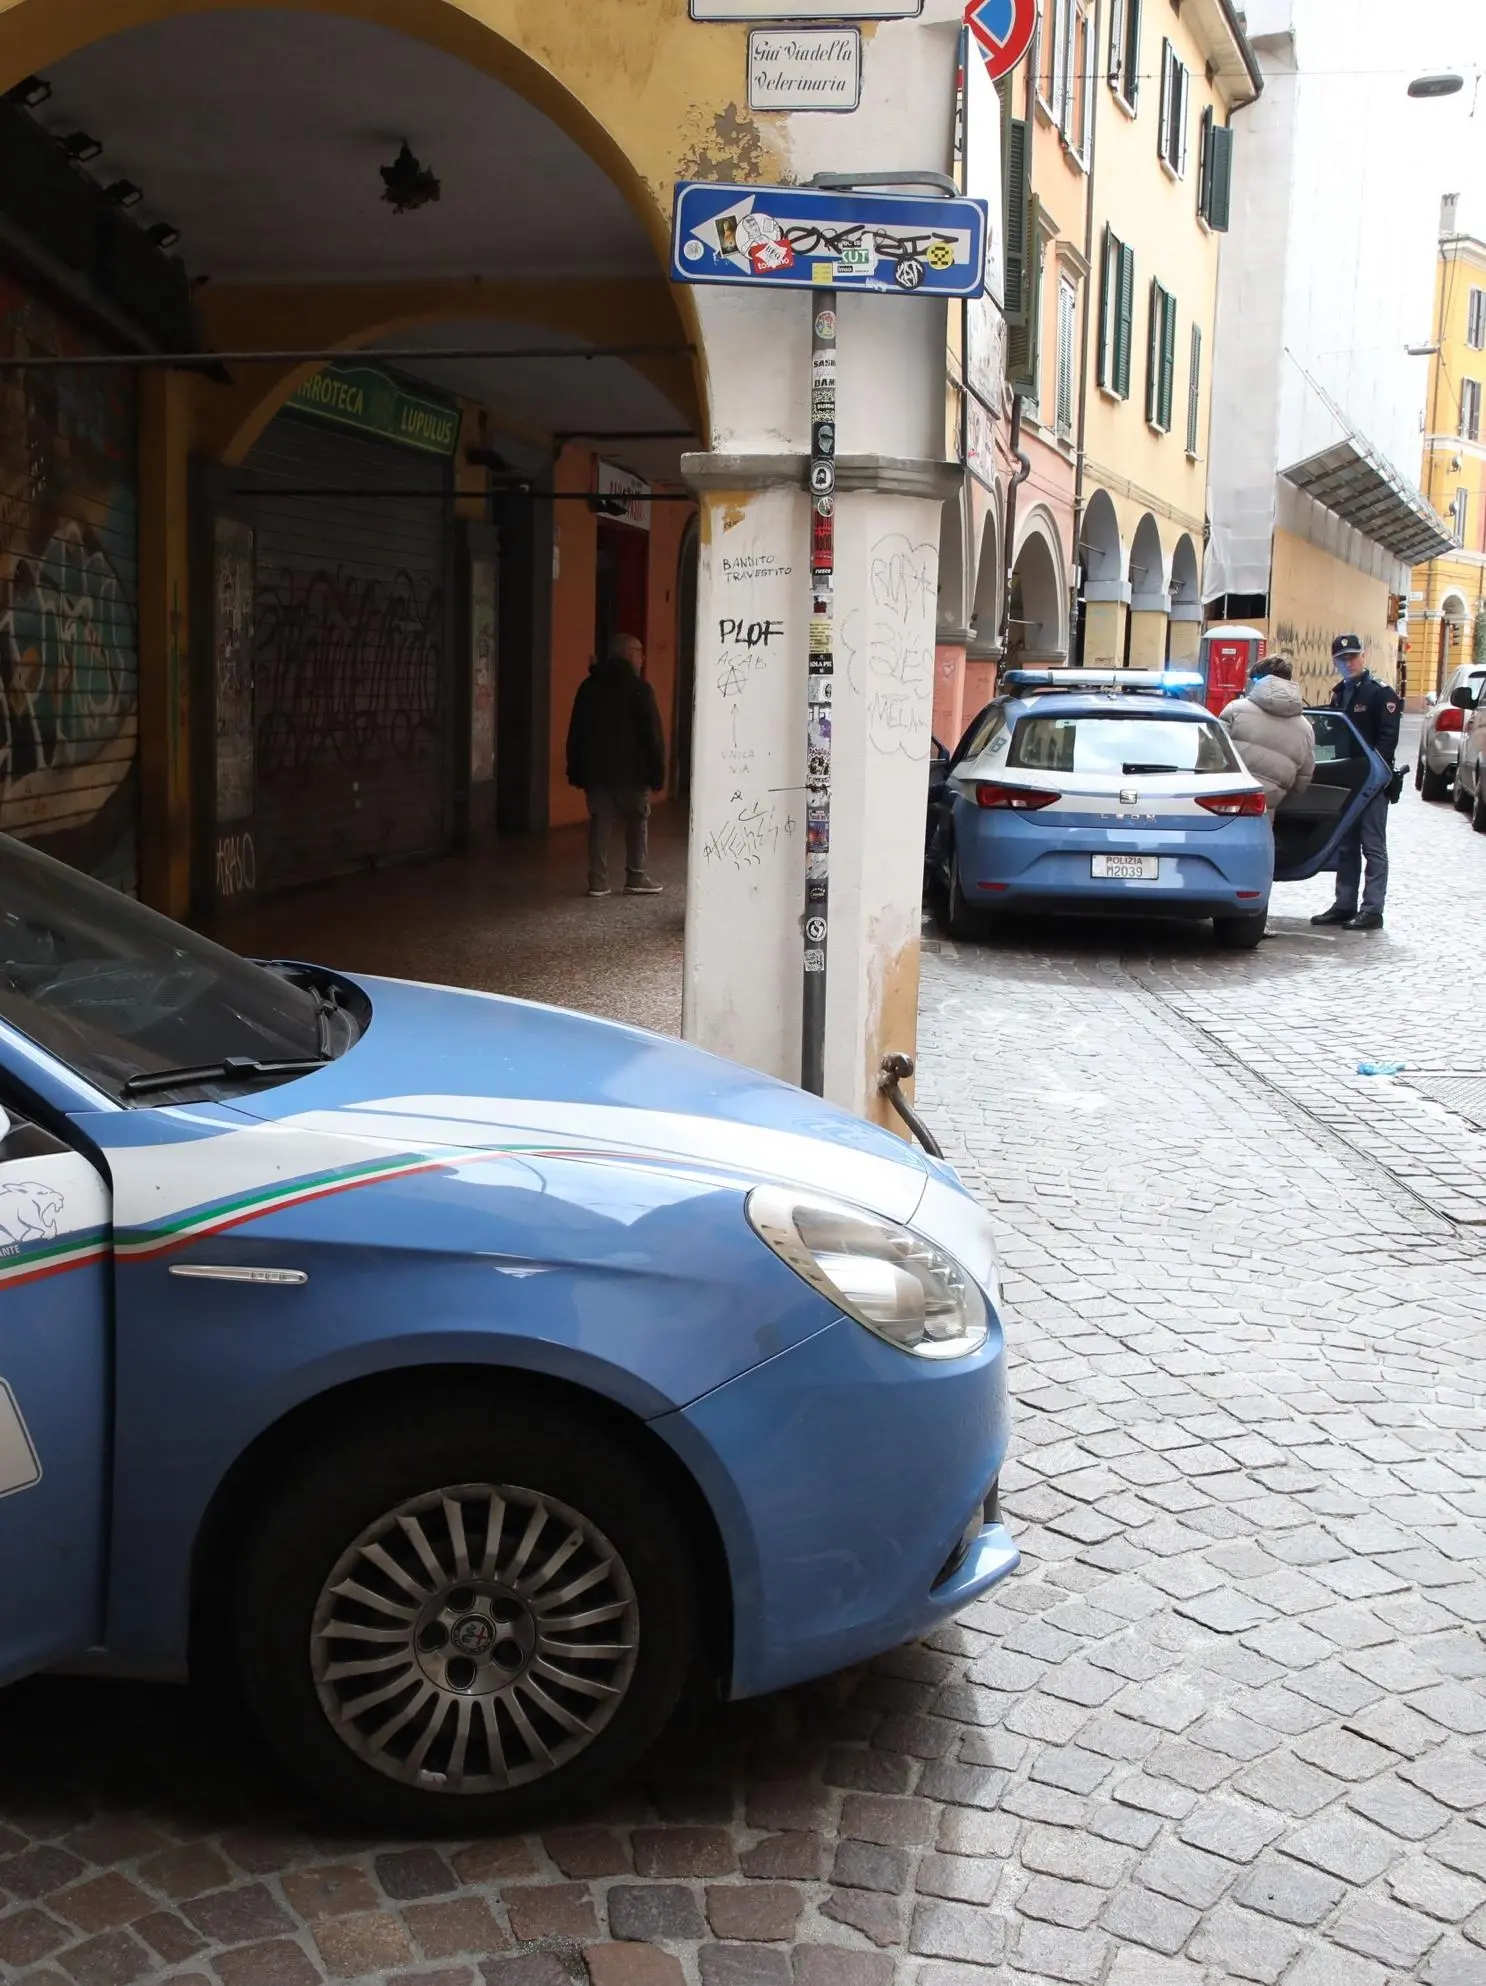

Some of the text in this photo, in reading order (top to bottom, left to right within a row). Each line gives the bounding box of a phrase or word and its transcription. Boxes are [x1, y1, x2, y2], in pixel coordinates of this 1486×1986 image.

[400, 405, 453, 444] LUPULUS
[1105, 856, 1143, 866] POLIZIA
[1106, 865, 1143, 878] M2039
